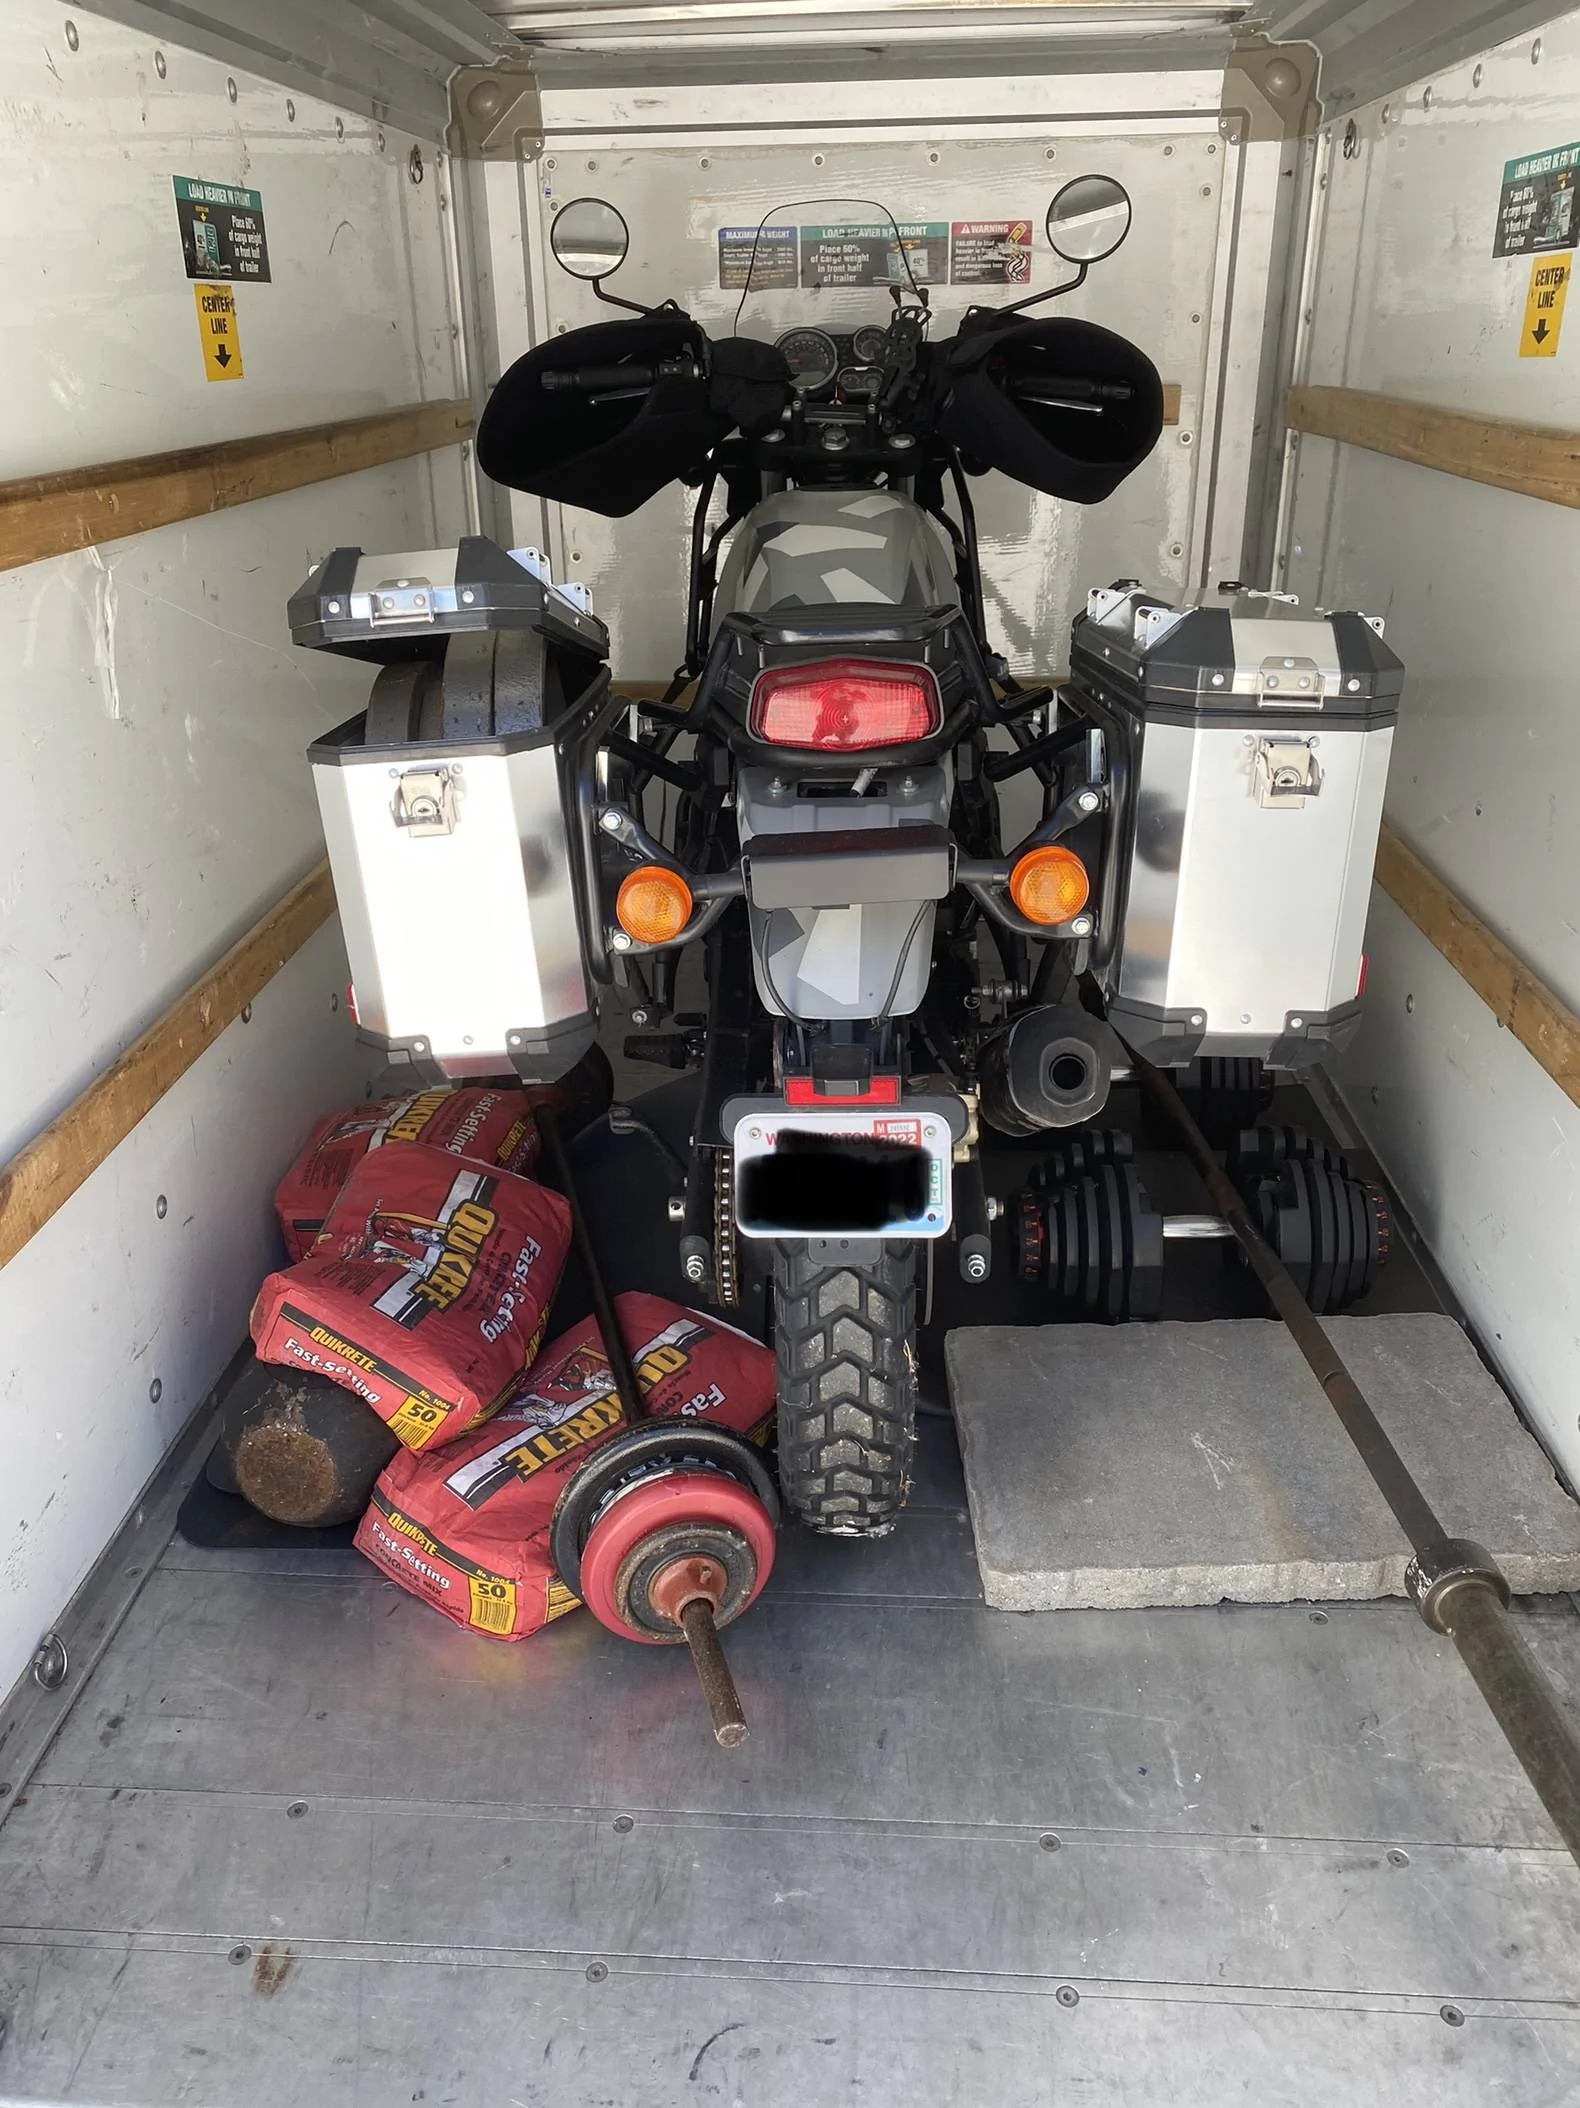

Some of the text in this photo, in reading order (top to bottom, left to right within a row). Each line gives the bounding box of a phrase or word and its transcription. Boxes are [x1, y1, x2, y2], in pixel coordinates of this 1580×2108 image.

[188, 183, 204, 199] LOAD
[822, 228, 845, 239] LOAD
[847, 227, 881, 238] HEAVIER
[970, 224, 1009, 233] WARNING
[819, 244, 861, 254] Place 60%
[810, 254, 870, 264] of cargo weight
[818, 264, 863, 273] in front half
[823, 274, 857, 283] of trailer
[1535, 267, 1565, 287] CENTER
[202, 296, 231, 313] CENTER
[1537, 291, 1556, 308] LINE
[211, 318, 228, 334] LINE
[308, 1326, 378, 1373] QUIKRETE
[284, 1337, 382, 1404] Fast-Setting
[407, 1403, 438, 1423] 50
[477, 1583, 507, 1599] 50
